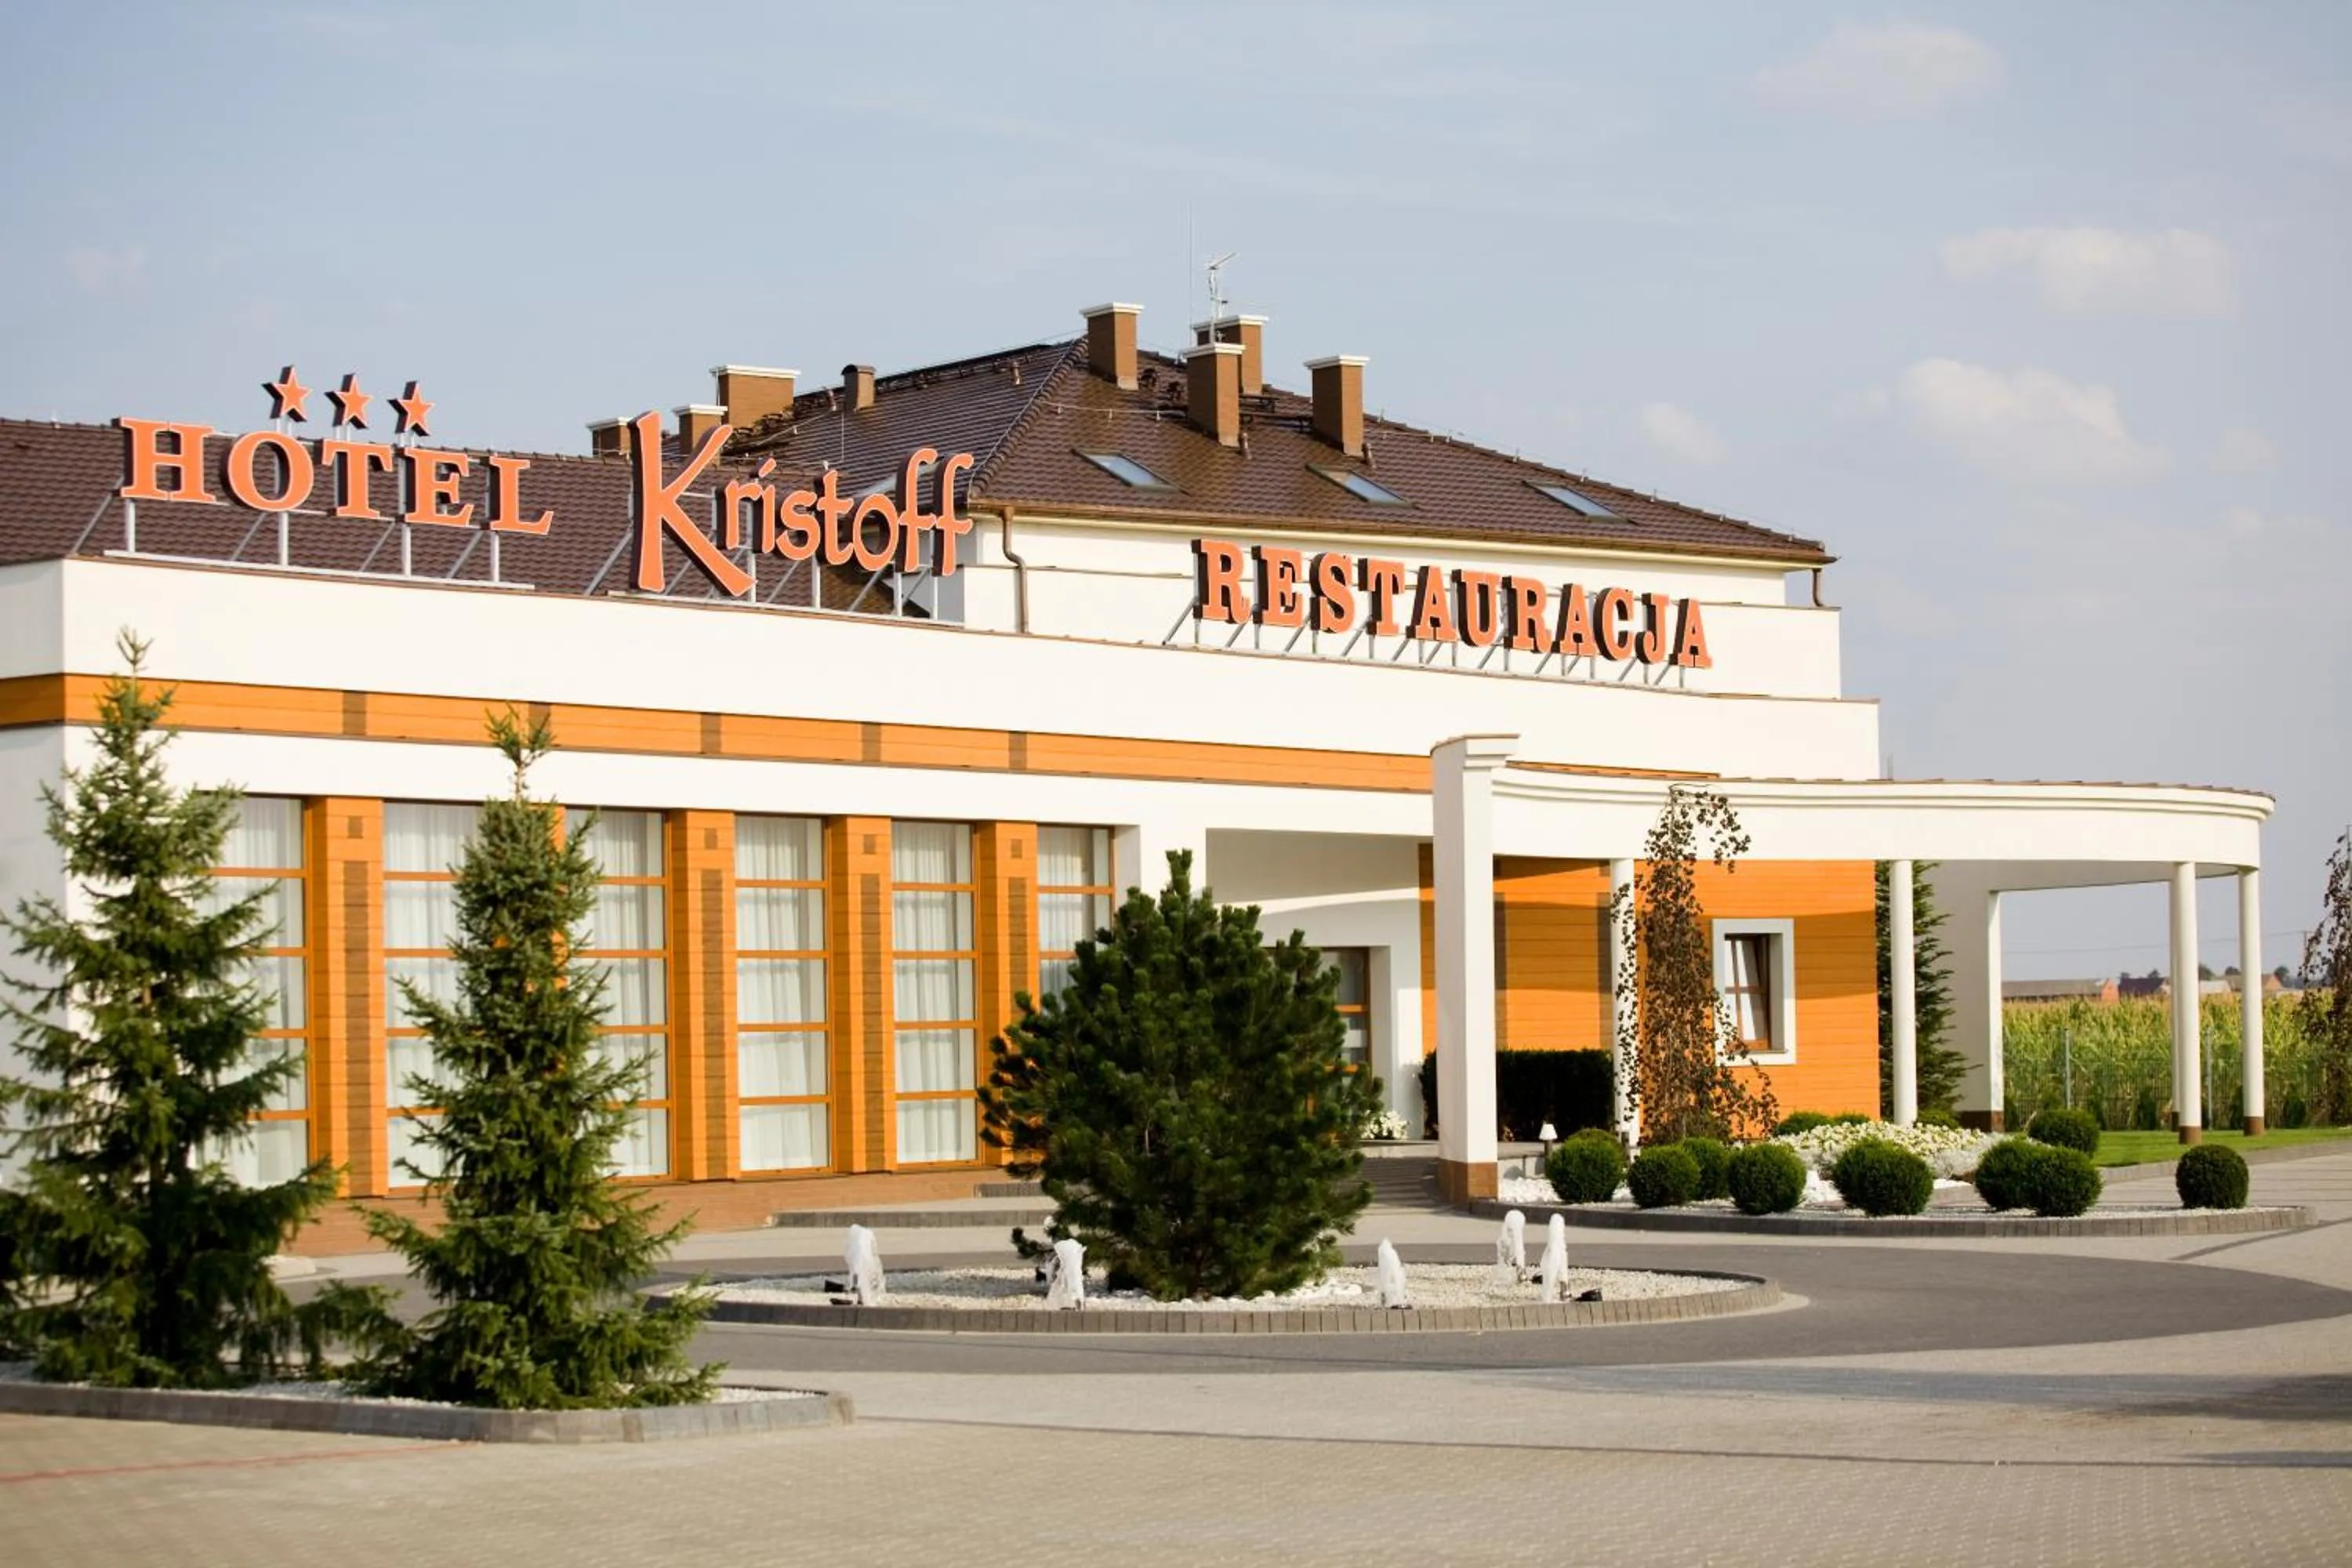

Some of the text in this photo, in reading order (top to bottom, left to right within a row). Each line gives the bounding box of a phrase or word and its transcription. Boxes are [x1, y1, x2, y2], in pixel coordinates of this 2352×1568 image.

[114, 410, 974, 597] HOTEL Kristoff
[1192, 539, 1713, 669] RESTAURACJA
